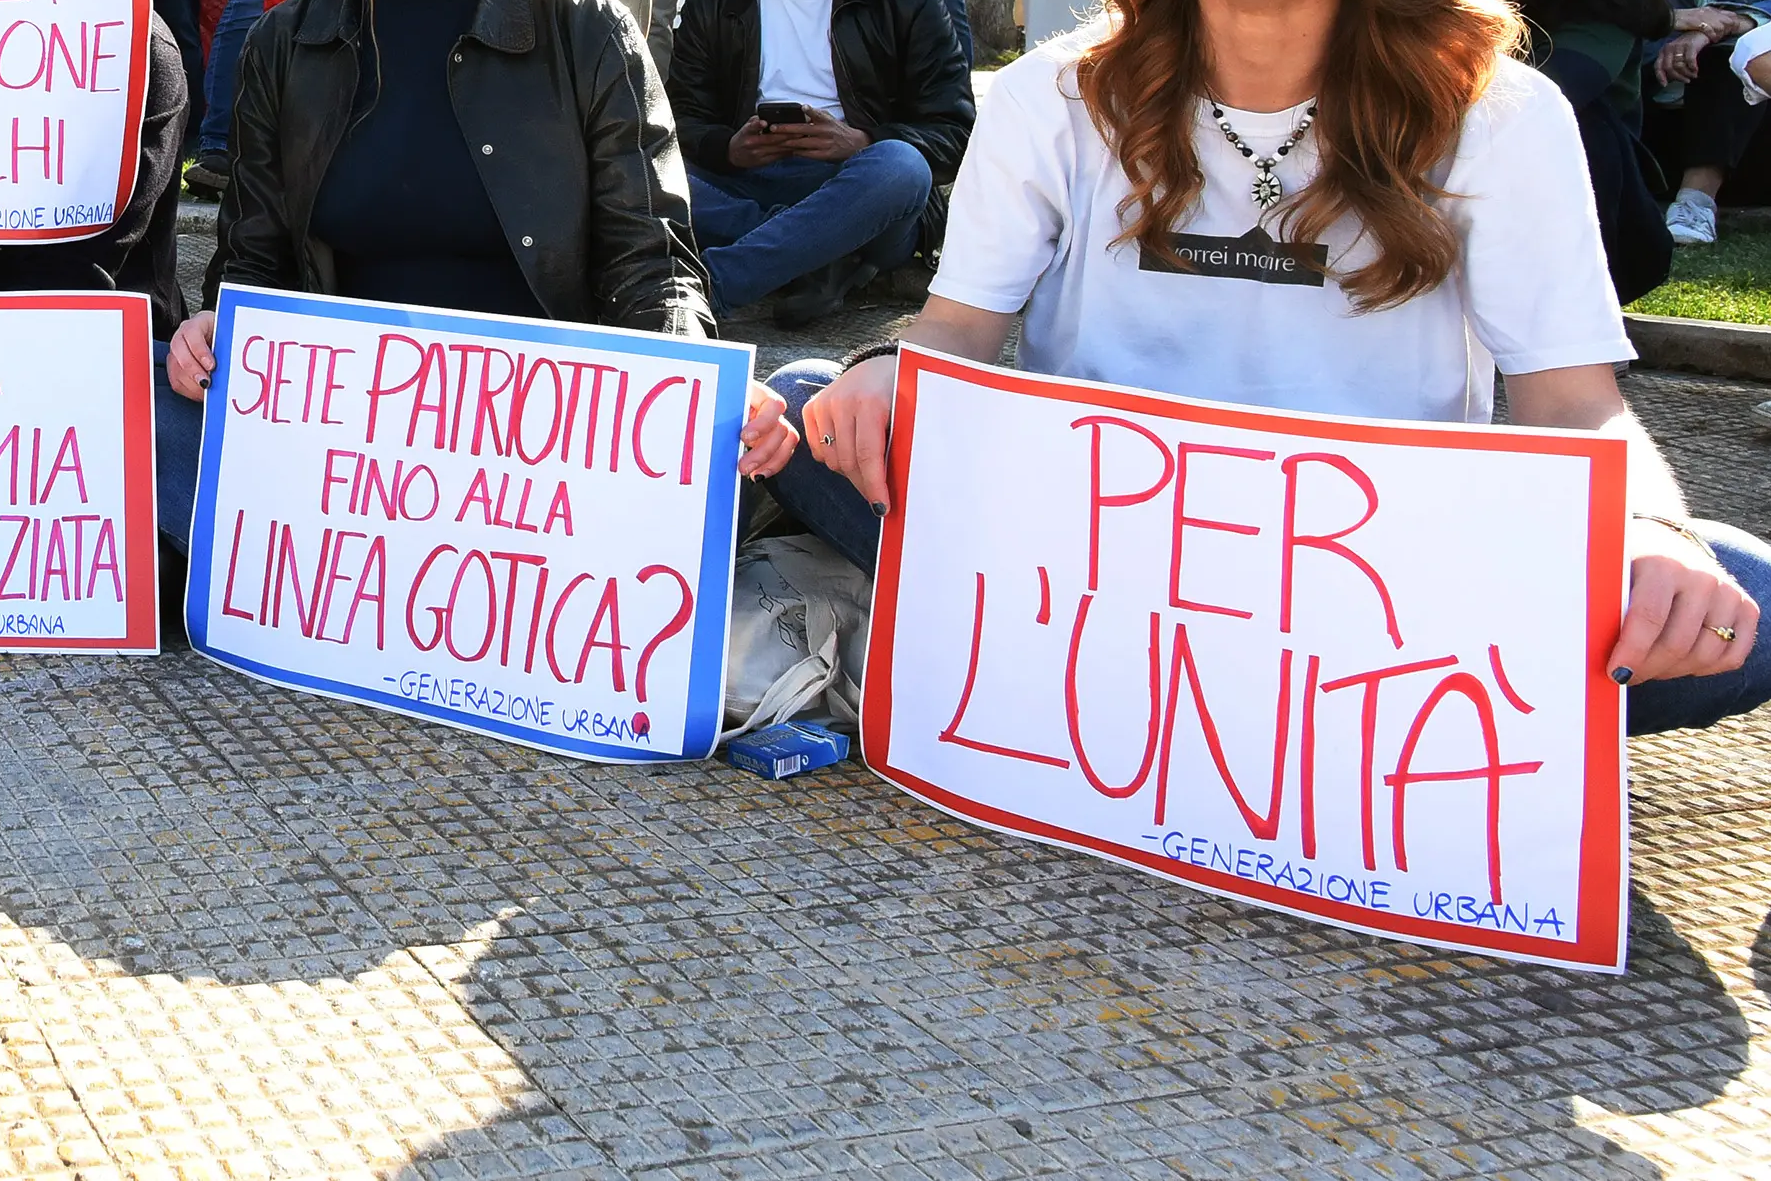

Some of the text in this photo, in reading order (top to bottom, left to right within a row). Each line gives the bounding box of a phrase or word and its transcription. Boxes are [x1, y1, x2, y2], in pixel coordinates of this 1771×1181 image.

[54, 203, 114, 224] URBANA
[232, 333, 702, 485] SIETE PATRIOTTICI
[320, 448, 574, 537] FINO ALLA
[1070, 415, 1404, 649] PER
[221, 509, 694, 735] LINEA GOTICA?
[562, 709, 651, 744] URBANA
[1413, 890, 1566, 937] URBANA
